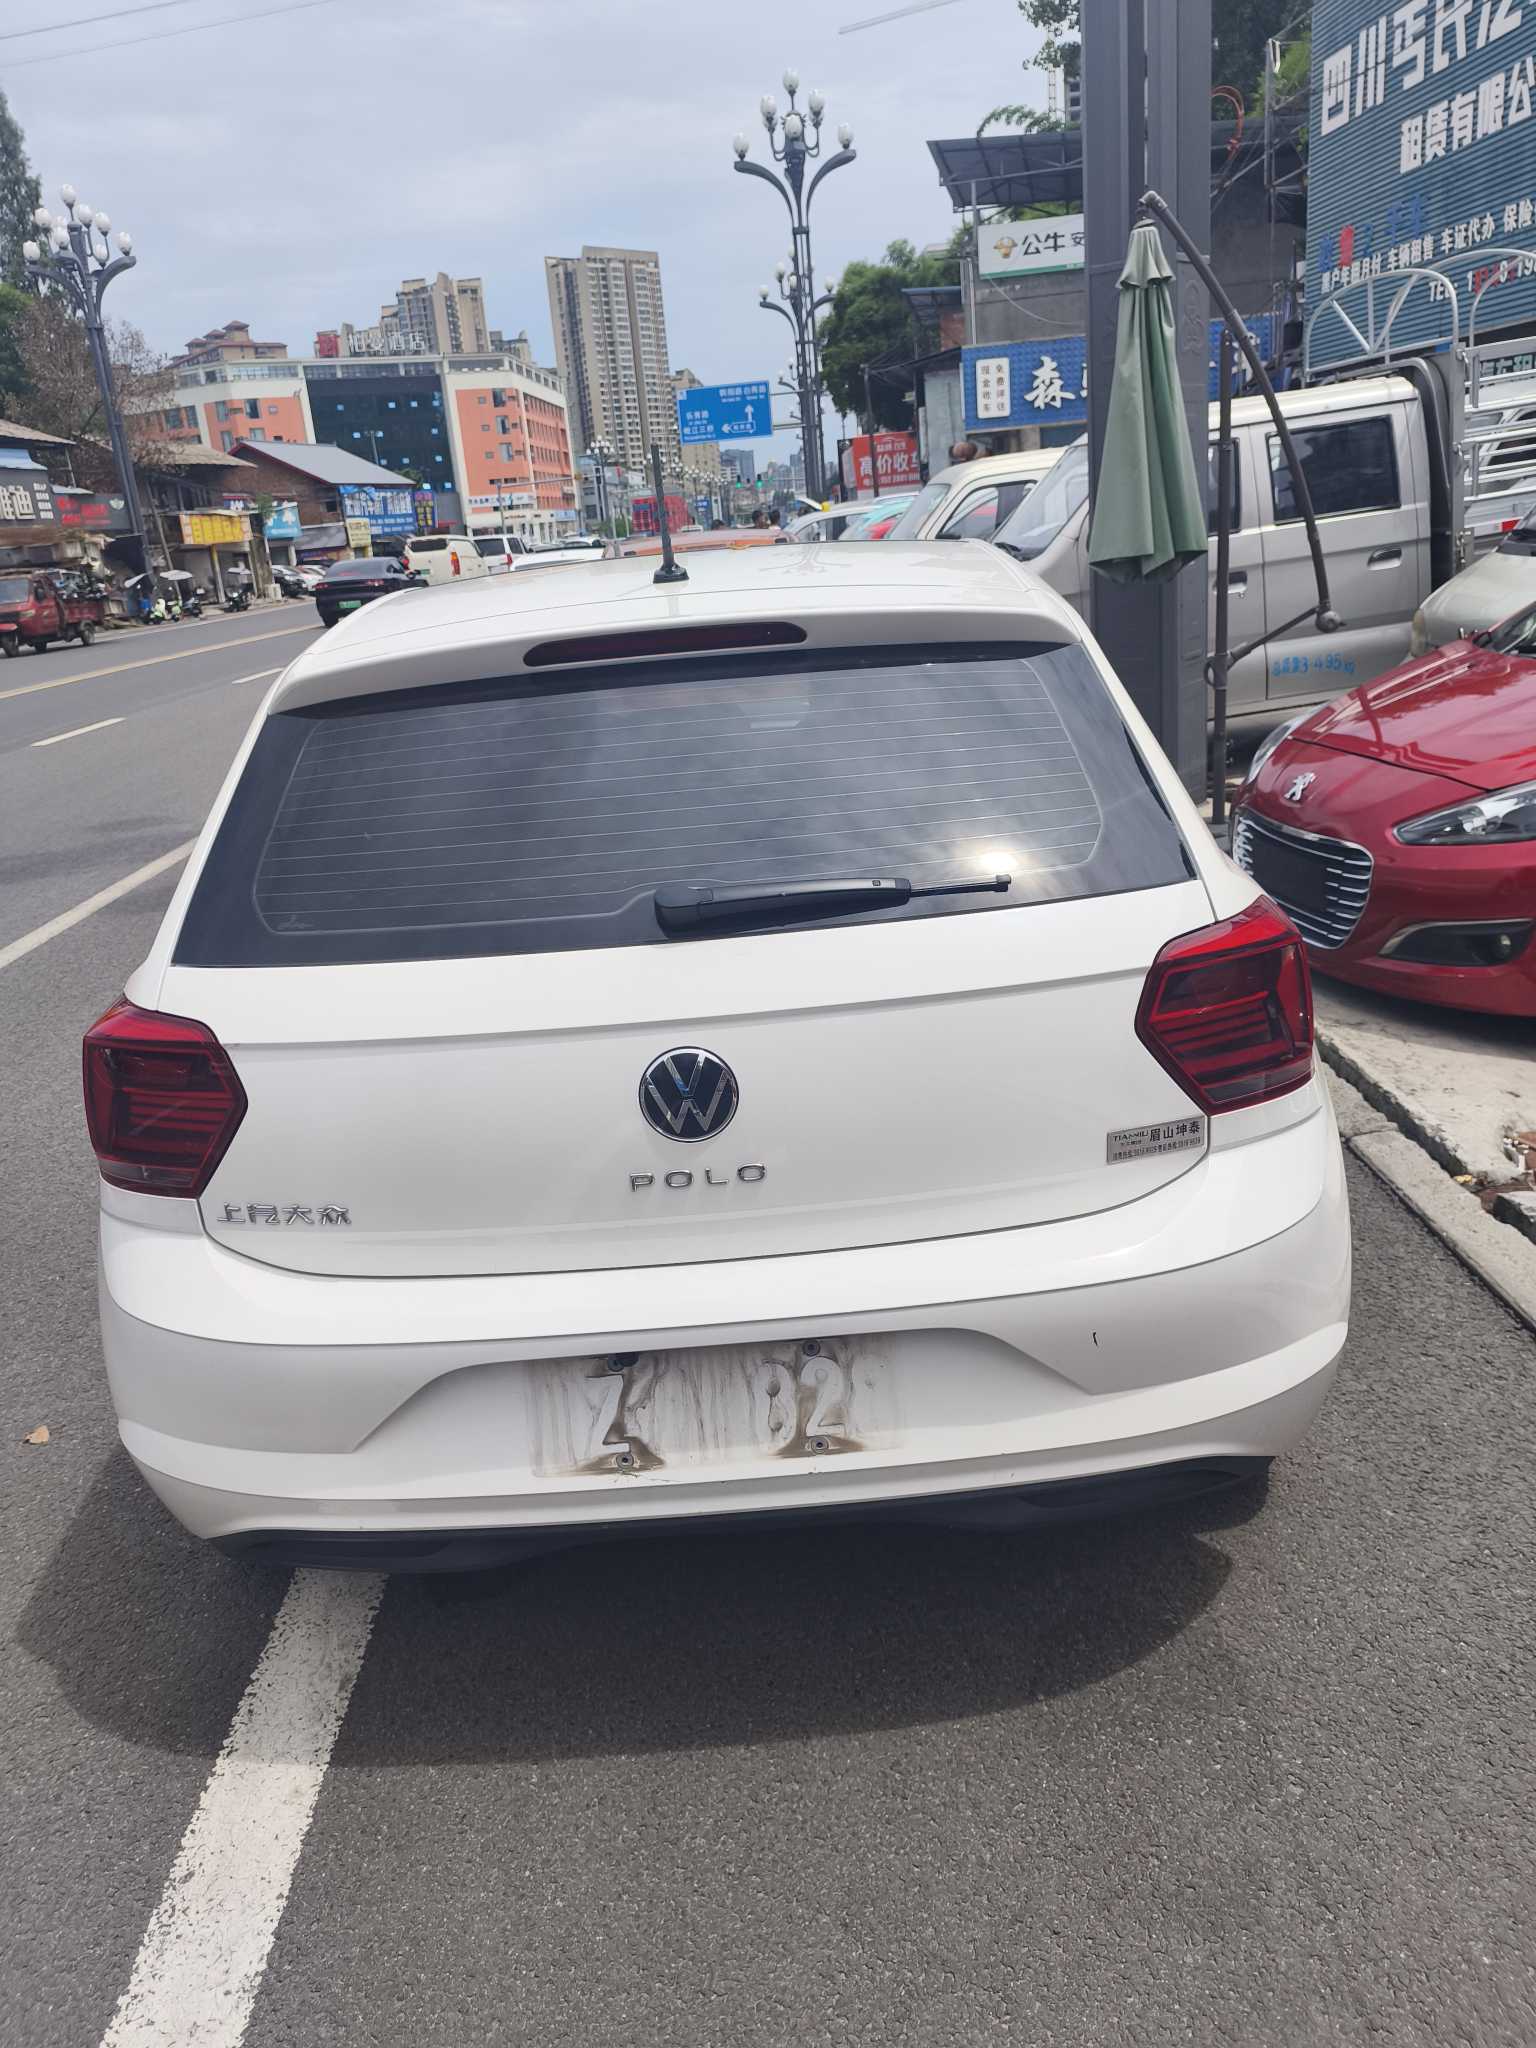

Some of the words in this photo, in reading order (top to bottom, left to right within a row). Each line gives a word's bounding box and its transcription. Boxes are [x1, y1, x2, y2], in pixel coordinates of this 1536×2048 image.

[1503, 197, 1536, 233] 保险
[1023, 355, 1088, 410] 森
[1149, 1120, 1201, 1142] 眉山坤泰
[629, 1162, 767, 1193] POLO
[216, 1201, 353, 1226] 上汽大众
